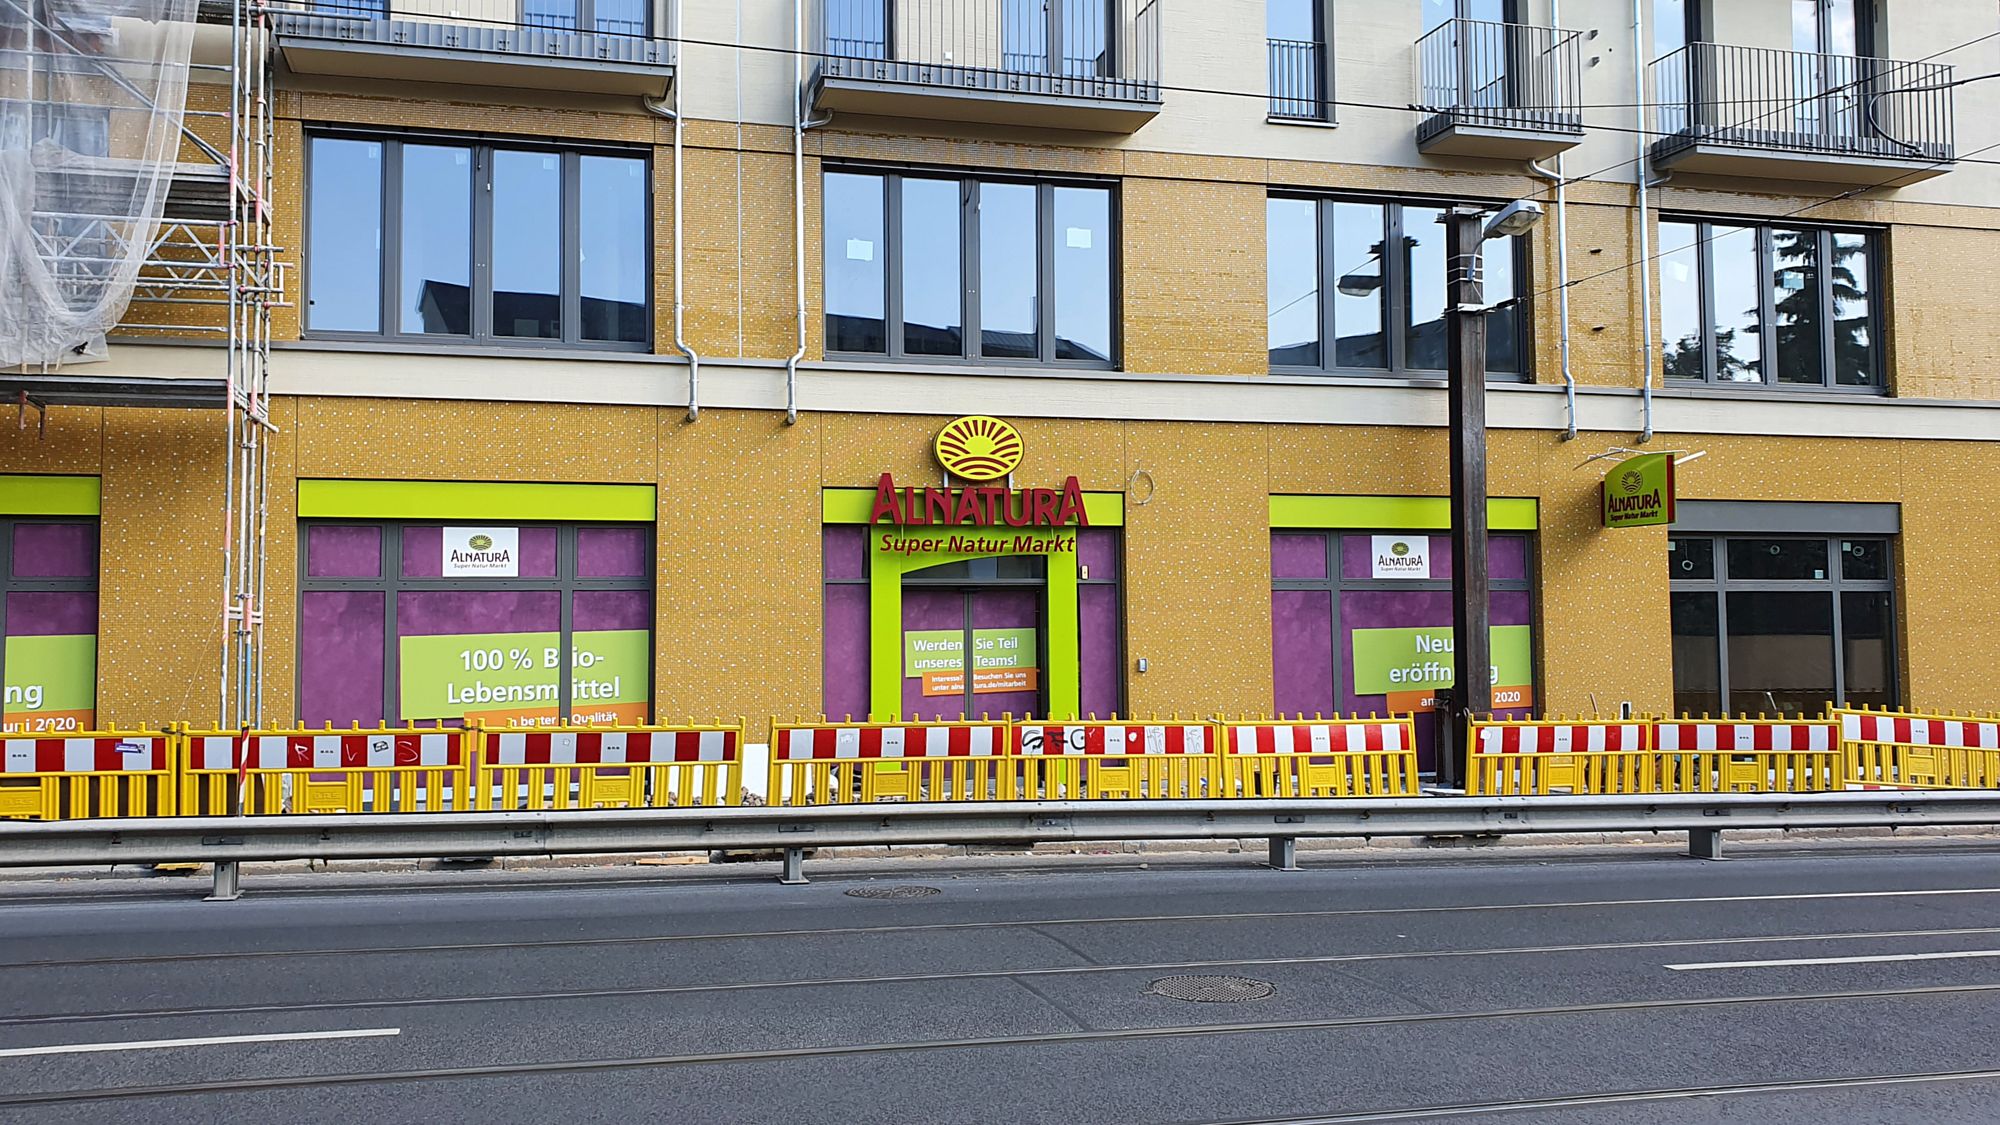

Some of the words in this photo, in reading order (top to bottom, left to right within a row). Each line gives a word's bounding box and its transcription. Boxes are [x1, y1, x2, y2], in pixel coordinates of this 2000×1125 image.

[870, 472, 1089, 527] ALNATURA
[1608, 488, 1662, 513] ALNATURA
[880, 534, 944, 556] Super
[948, 535, 1008, 553] Natur
[1012, 534, 1075, 553] Markt
[450, 549, 510, 563] ALNATURA
[1378, 554, 1423, 566] ALNATURA
[913, 639, 963, 652] Werden
[975, 638, 993, 650] Sie
[997, 637, 1018, 649] Teil
[459, 648, 504, 671] 100
[509, 647, 533, 670] %
[543, 646, 604, 669] Bio-
[914, 658, 963, 669] unseres
[975, 655, 1017, 667] Teams!
[1389, 662, 1498, 685] eröffng
[447, 676, 620, 704] Lebensmittel
[1494, 691, 1521, 703] 2020
[520, 715, 556, 727] beter
